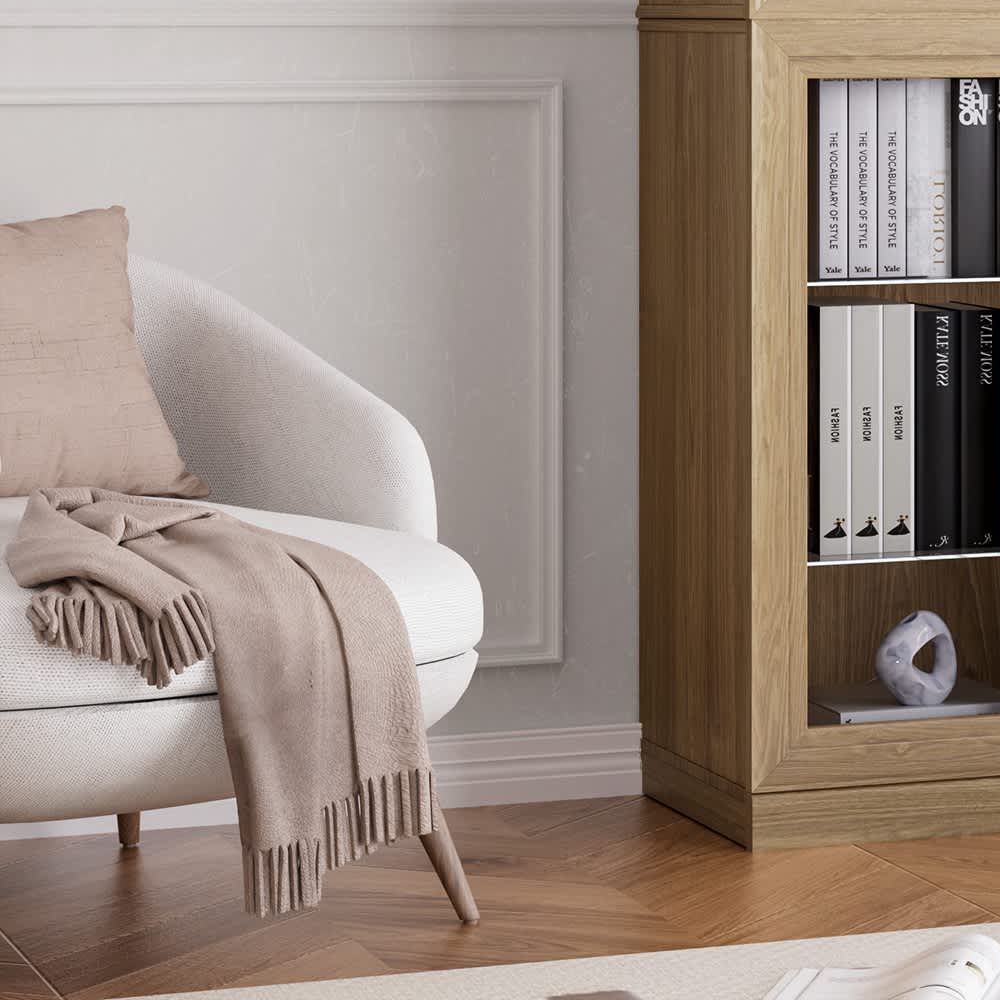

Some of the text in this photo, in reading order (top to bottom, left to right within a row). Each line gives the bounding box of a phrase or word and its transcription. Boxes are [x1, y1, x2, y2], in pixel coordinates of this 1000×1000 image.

[829, 131, 839, 249] THE VOCABULARY OF STYLE
[858, 131, 868, 249] THE VOCABULARY OF STYLE
[887, 131, 897, 248] THE VOCABULARY OF STYLE
[825, 266, 842, 274] Yale
[883, 265, 900, 273] Yale
